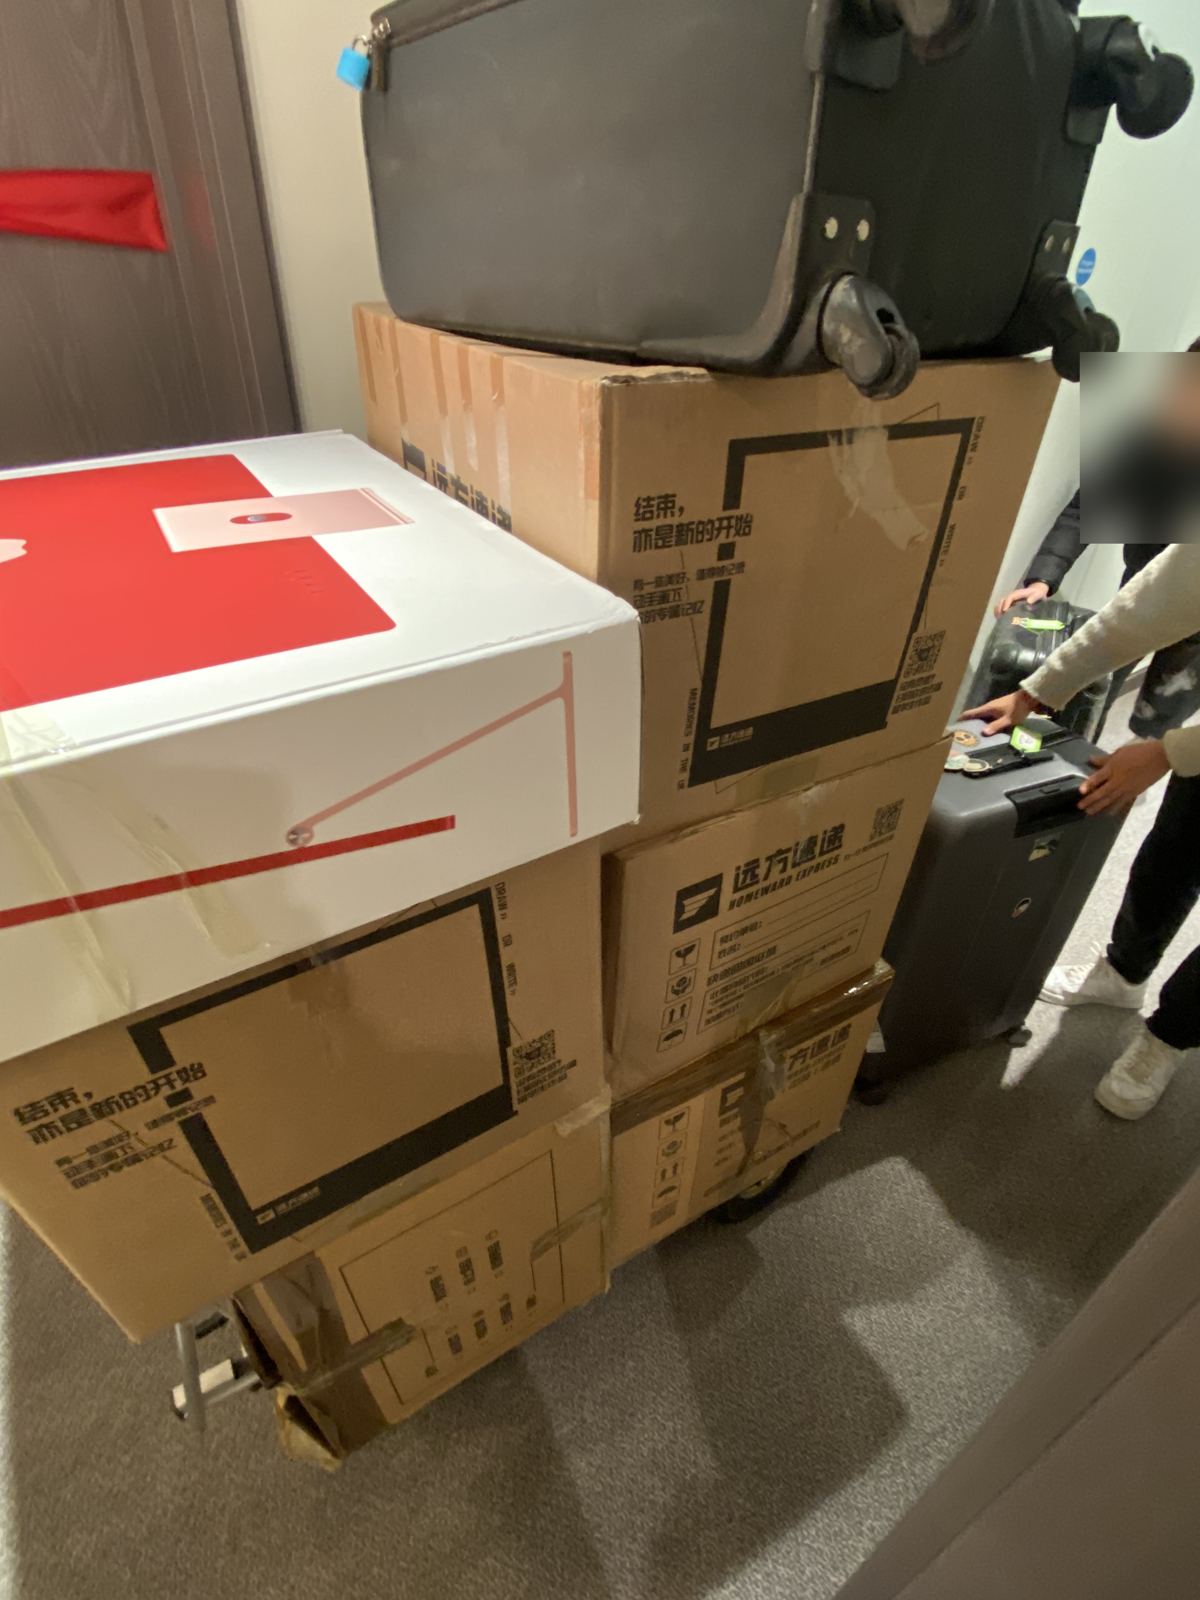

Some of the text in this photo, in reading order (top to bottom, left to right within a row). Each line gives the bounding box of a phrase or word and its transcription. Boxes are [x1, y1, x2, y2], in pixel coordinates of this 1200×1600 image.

[632, 512, 754, 553] 亦是新的开始
[727, 854, 841, 912] HOMEWARD EXPRESS
[732, 823, 845, 894] 远方速递
[27, 1062, 207, 1145] 亦是新的开始
